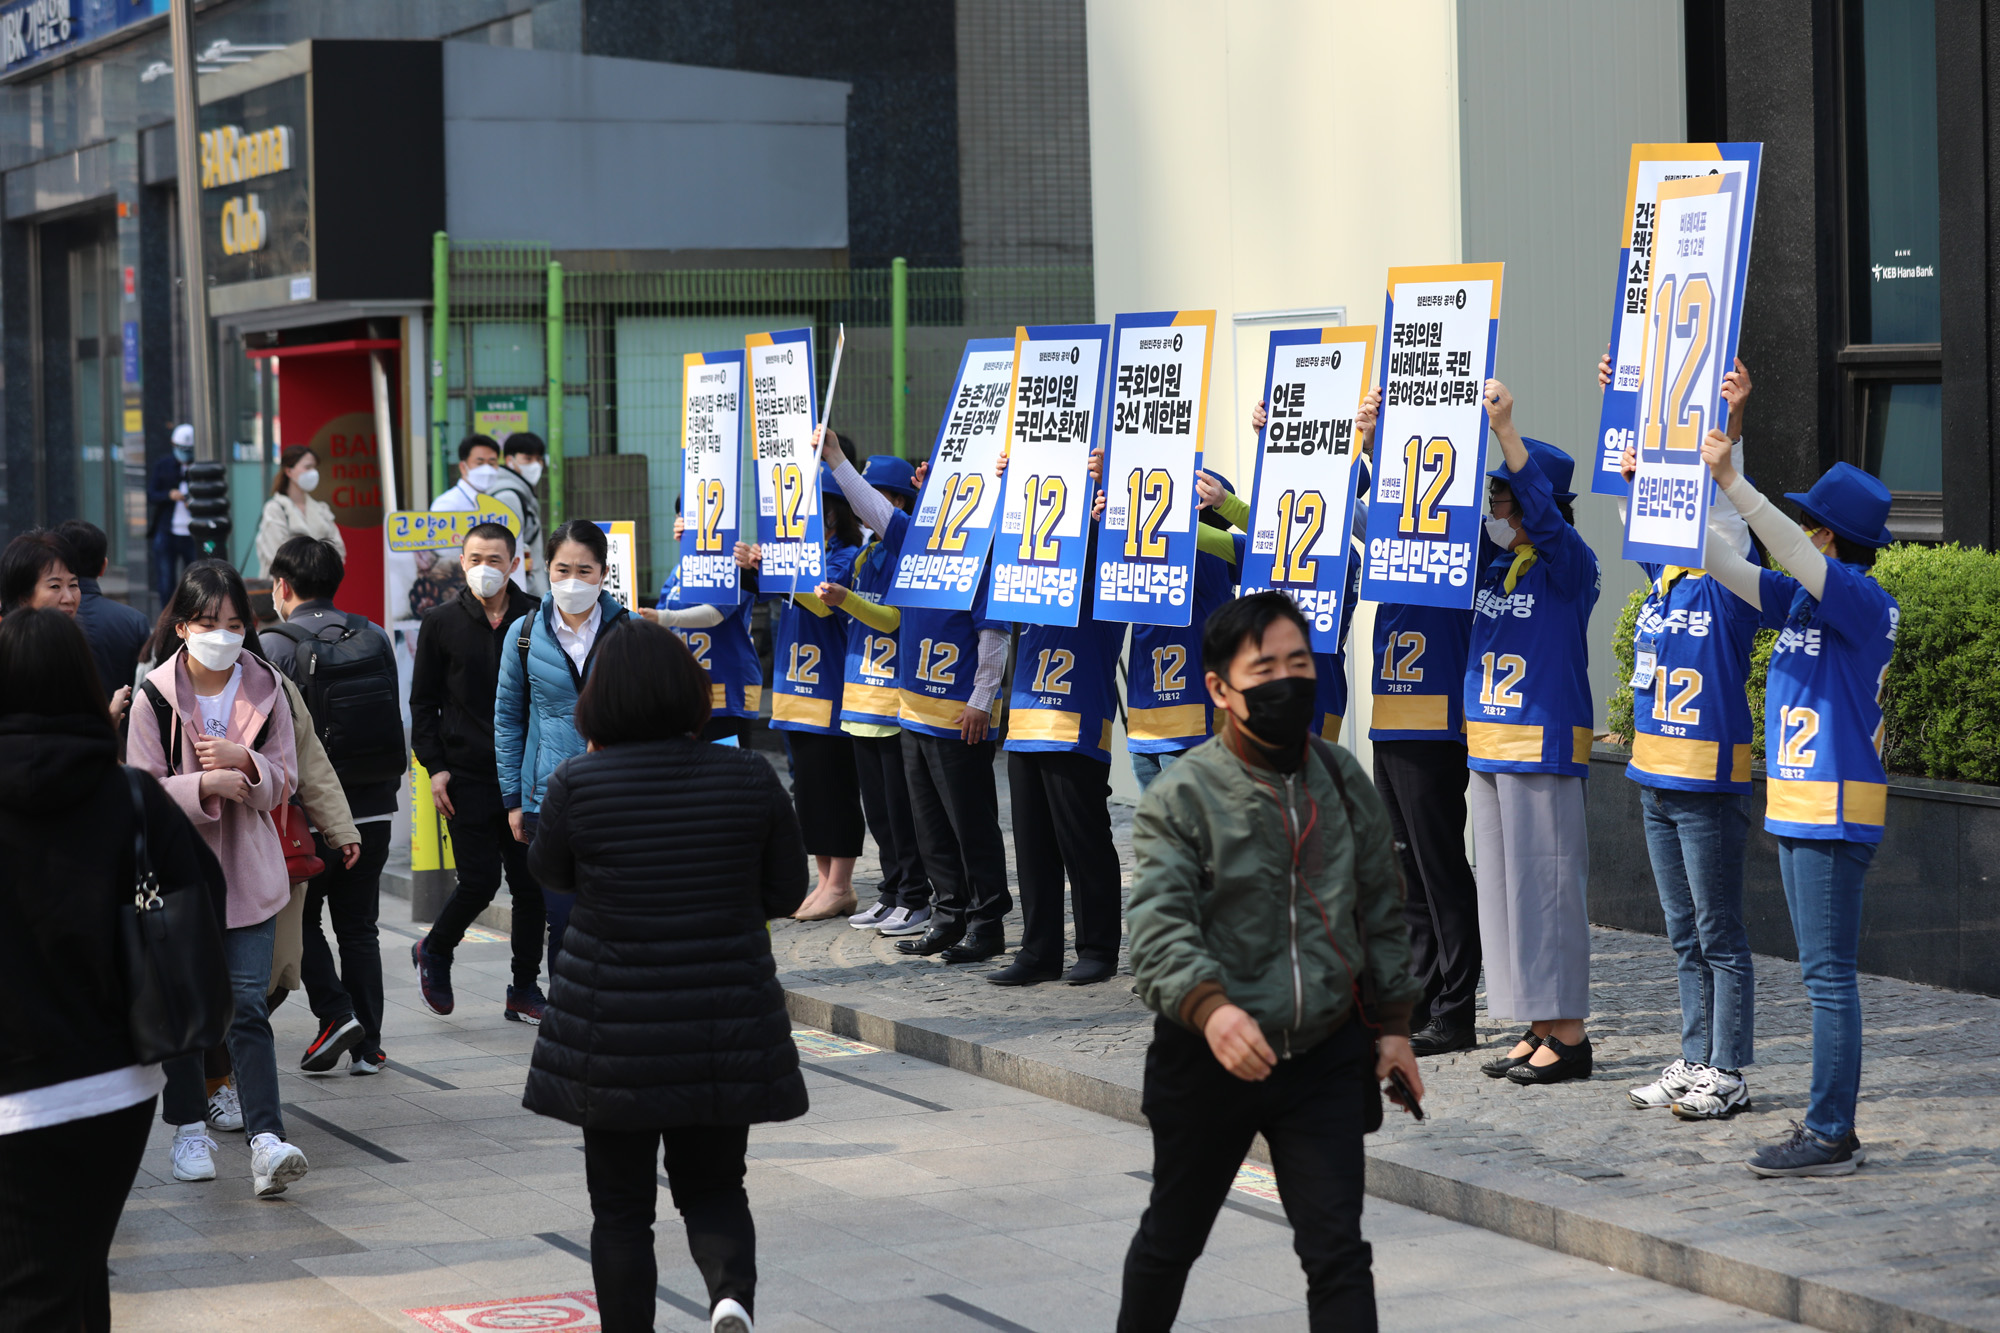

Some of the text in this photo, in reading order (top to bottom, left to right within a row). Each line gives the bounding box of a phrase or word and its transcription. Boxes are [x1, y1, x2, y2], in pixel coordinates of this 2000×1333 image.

[221, 193, 266, 255] Club
[1680, 211, 1707, 233] 비례대표
[1677, 237, 1704, 257] 기호12번
[1895, 249, 1911, 257] BANK
[1883, 265, 1933, 279] KEB Hana Bank
[1417, 295, 1443, 307] 열린민주당
[1444, 295, 1455, 306] 공약
[1140, 339, 1161, 349] 열린민주당
[1163, 339, 1172, 349] 공약
[1393, 322, 1442, 348] 국회의원
[1296, 357, 1319, 367] 열린민주당
[1321, 356, 1330, 366] 공약
[1391, 351, 1471, 377] 비례대표, 국민
[1642, 272, 1716, 465] 12
[755, 376, 776, 396] 악의적
[958, 382, 1010, 408] 농촌재생
[1018, 375, 1078, 408] 국회의원
[1118, 363, 1182, 398] 국회의원
[1389, 380, 1478, 406] 참여경선 의무화
[756, 395, 807, 417] 허위보도에 대한
[1114, 400, 1192, 434] 3선 제한법
[1272, 383, 1305, 418] 언론
[757, 418, 778, 438] 징벌적
[950, 410, 1001, 435] 뉴딜정책
[1015, 410, 1090, 443] 국민소환제
[1267, 419, 1352, 455] 오보방지법
[330, 433, 377, 457] BA
[759, 439, 794, 458] 손해배상제
[941, 437, 968, 462] 추진
[1381, 490, 1400, 499] 기호12번
[1382, 478, 1401, 487] 비례대표
[1398, 435, 1456, 540] 12
[1637, 476, 1698, 521] 열린민주당
[696, 479, 724, 554] 12
[772, 463, 804, 541] 12
[926, 472, 985, 555] 12
[1123, 468, 1174, 563] 12
[397, 514, 457, 538] 고양이
[1018, 475, 1067, 566] 12
[1257, 530, 1274, 539] 비례대표
[1269, 490, 1326, 588] 12
[682, 555, 736, 588] 열린민주당
[761, 542, 821, 576] 열린민주당
[895, 554, 979, 592] 열린민주당
[1369, 538, 1471, 586] 열린민주당
[993, 564, 1077, 607] 열린민주당
[1100, 561, 1188, 606] 열린민주당
[786, 642, 821, 684] 12
[860, 634, 896, 679] 12
[915, 638, 959, 685] 12
[1031, 649, 1075, 695] 12
[1151, 644, 1186, 692] 12
[1381, 631, 1426, 682] 12
[1387, 684, 1412, 692] 기호12
[1479, 652, 1526, 708] 12
[1652, 666, 1703, 725] 12
[1483, 705, 1506, 716] 기호12
[1660, 723, 1686, 736] 기호12
[1777, 705, 1819, 768] 12
